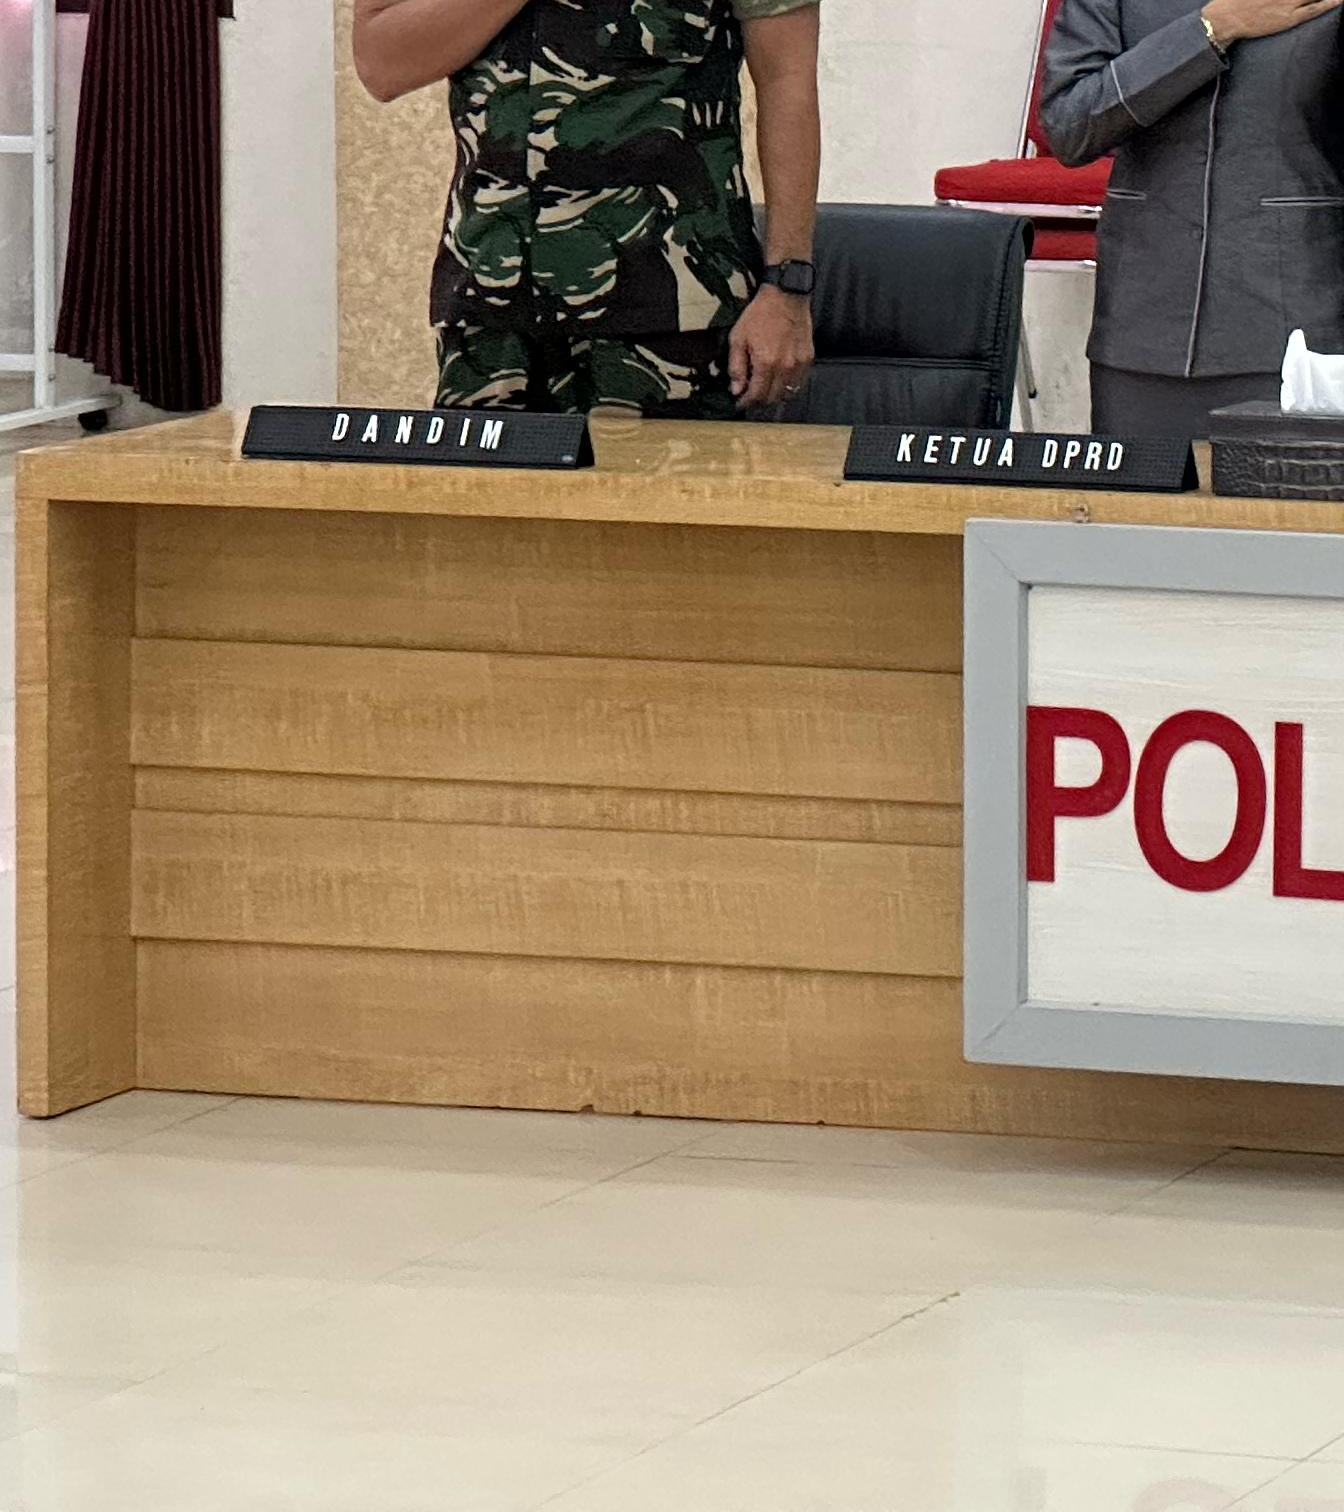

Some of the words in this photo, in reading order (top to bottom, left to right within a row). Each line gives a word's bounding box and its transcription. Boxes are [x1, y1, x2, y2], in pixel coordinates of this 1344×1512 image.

[331, 413, 504, 450] DANDIM
[896, 433, 1013, 467] KETUA
[1041, 439, 1124, 471] DPRD
